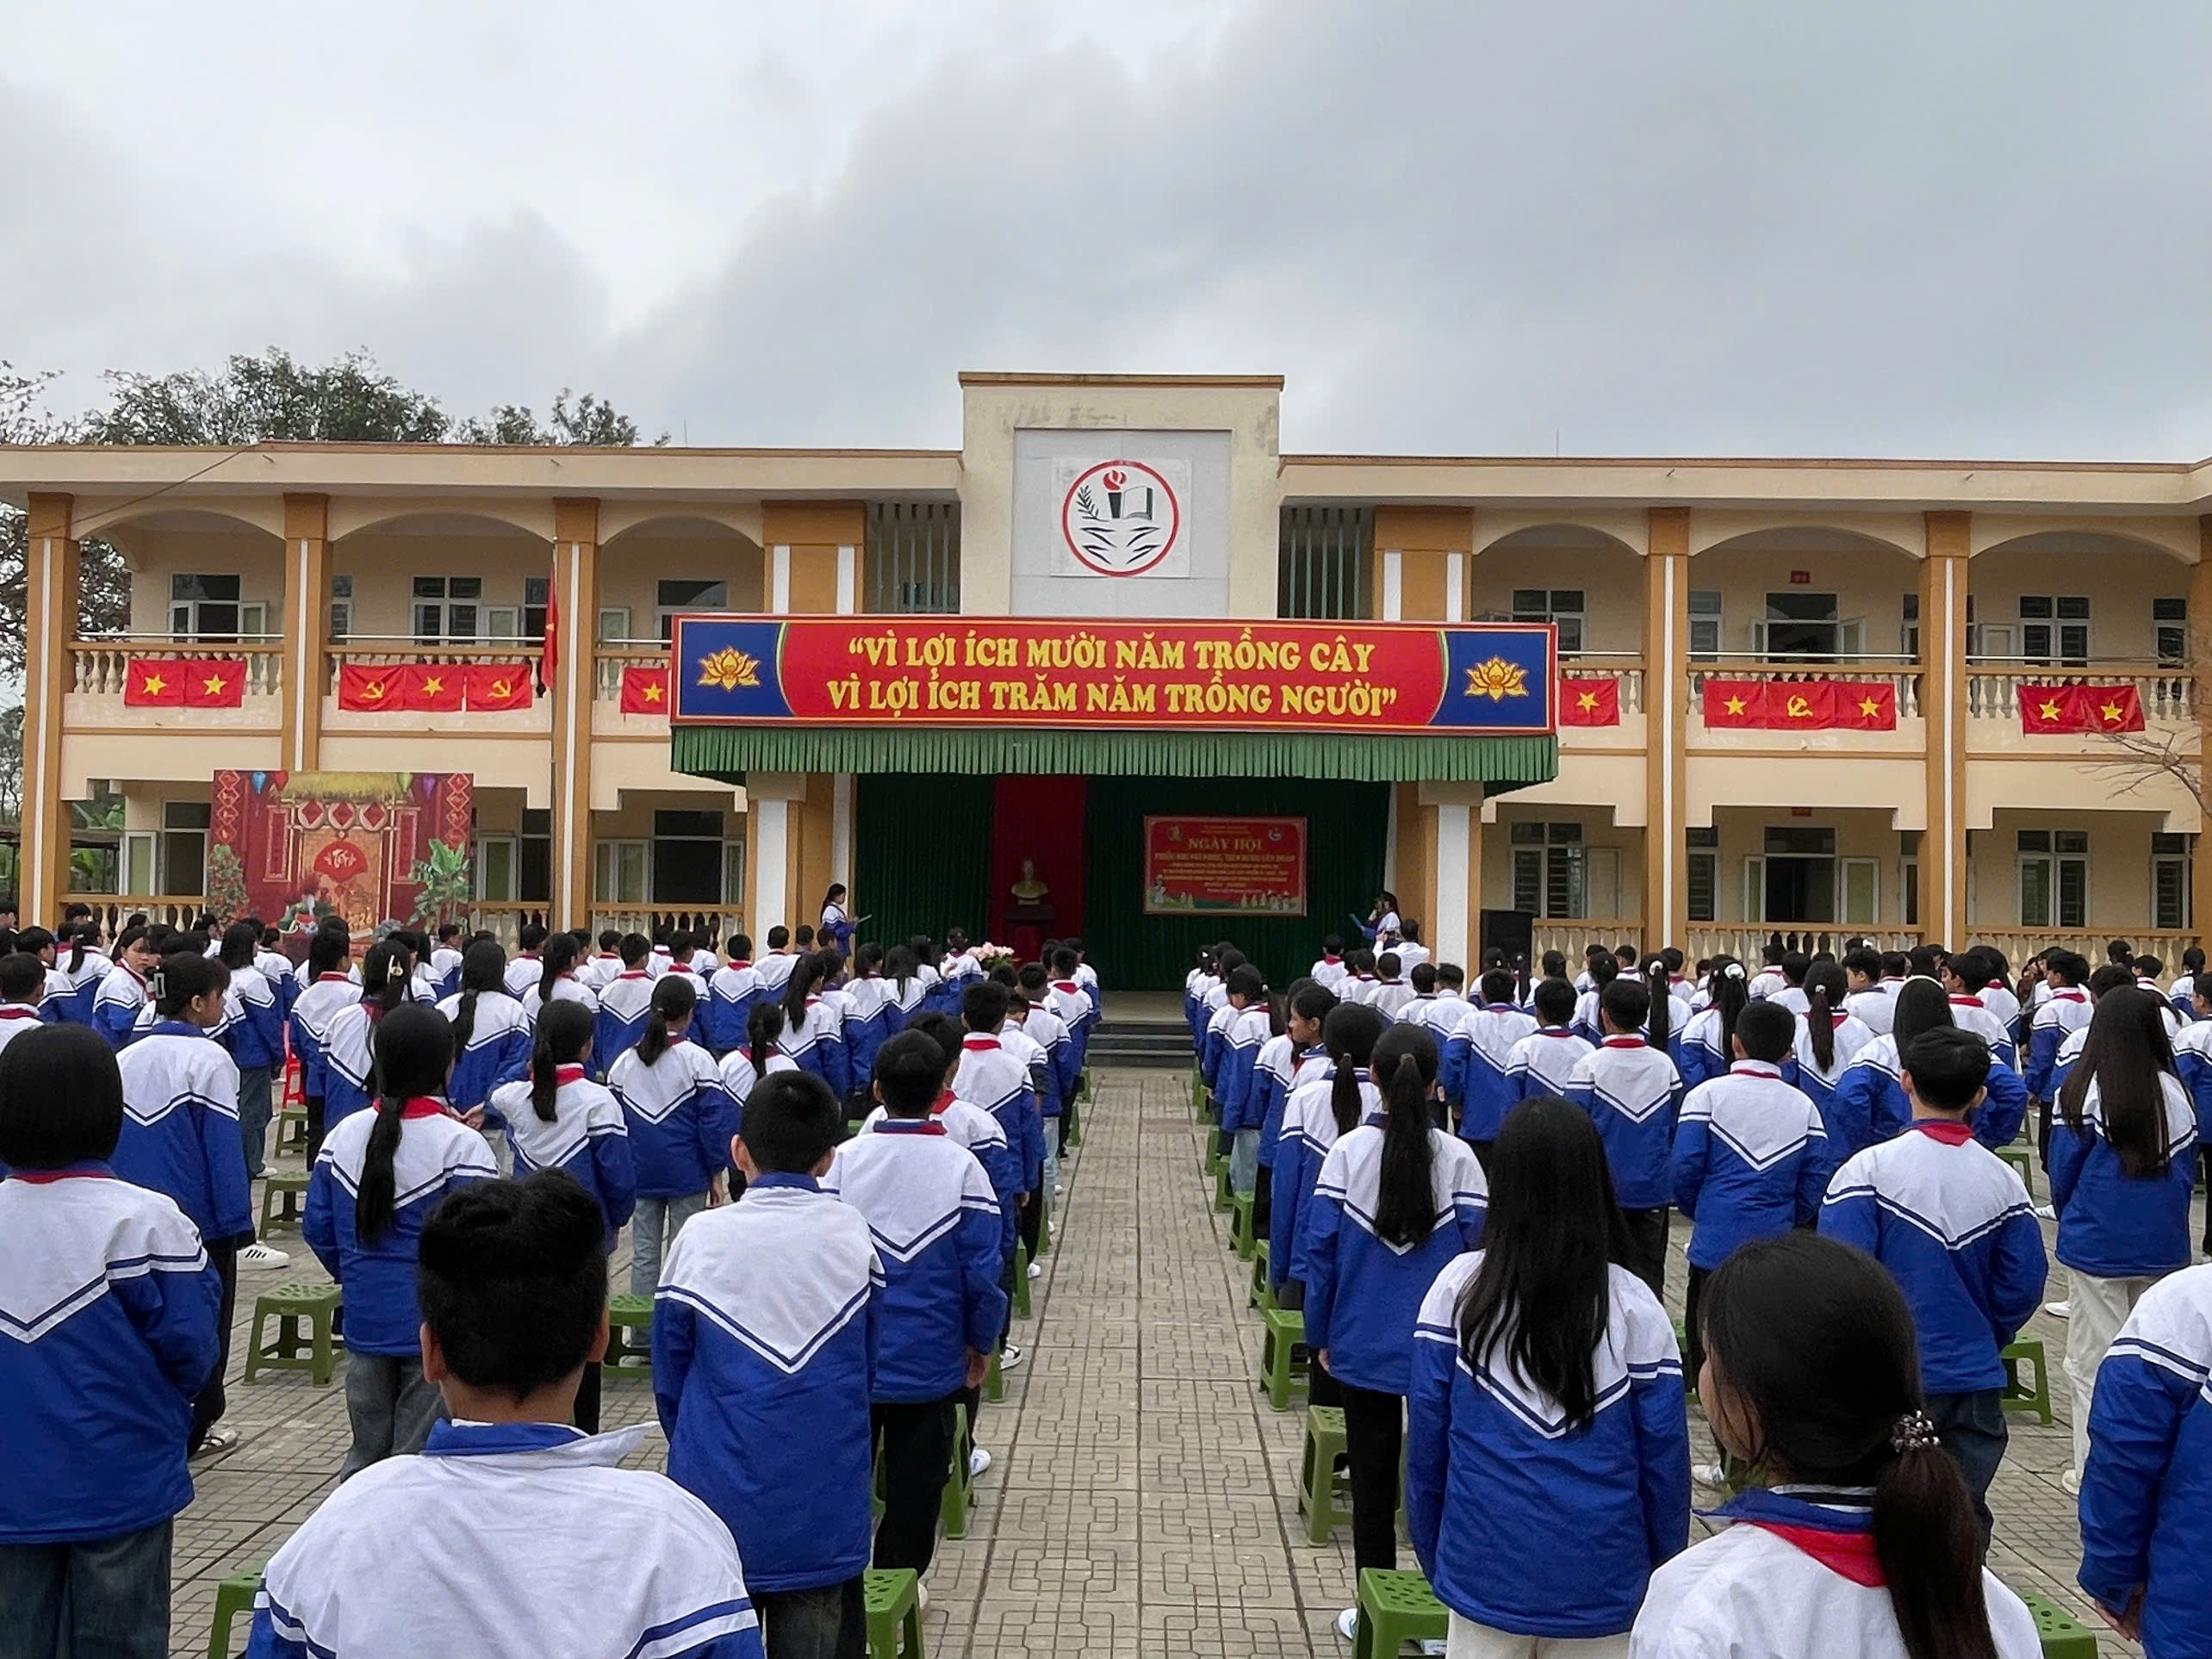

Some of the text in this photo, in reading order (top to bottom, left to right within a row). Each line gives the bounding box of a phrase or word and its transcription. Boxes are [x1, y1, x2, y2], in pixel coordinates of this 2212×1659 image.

[848, 627, 1376, 675] “VÌ LỢI ÍCH MƯỜI NĂM TRỒNG CÂY
[826, 669, 1397, 718] VÌ LỢI ÍCH TRĂM NĂM TRỒNG NGƯỜI”
[1188, 835, 1262, 852] NGÀY HỘI
